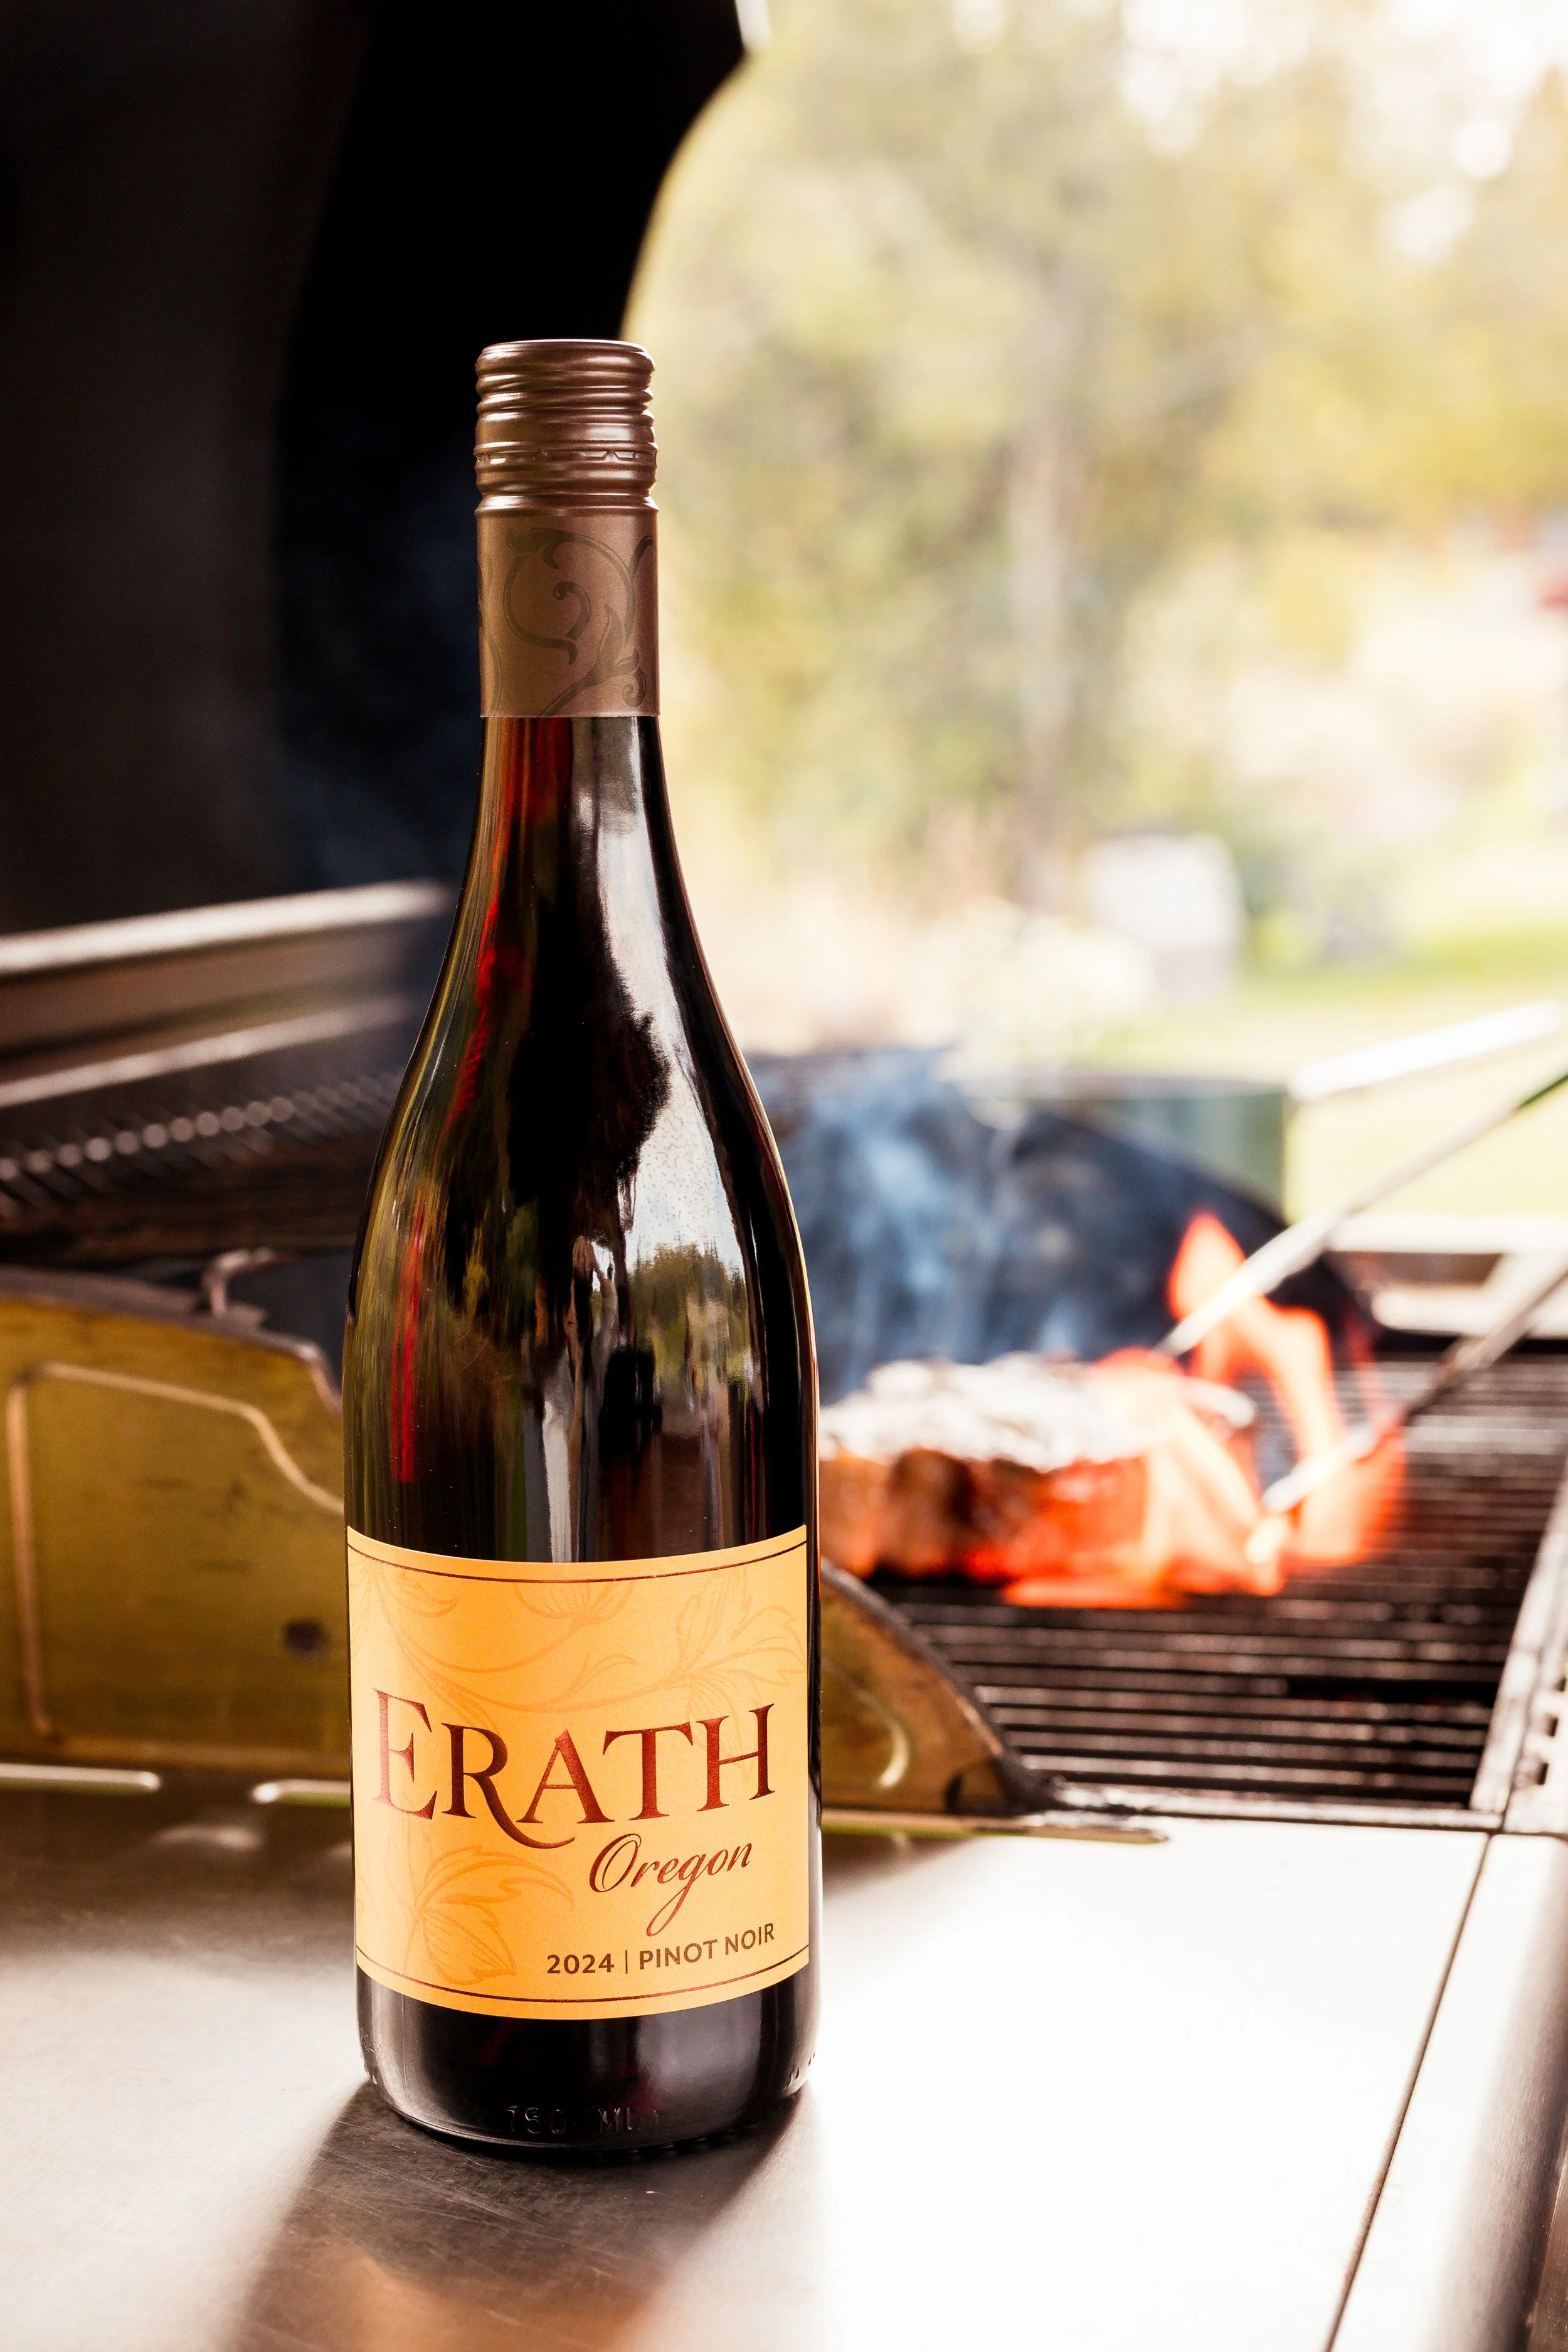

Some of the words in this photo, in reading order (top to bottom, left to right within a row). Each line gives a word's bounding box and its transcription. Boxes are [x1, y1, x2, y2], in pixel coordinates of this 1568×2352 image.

[373, 1688, 776, 1850] ERATH
[588, 1833, 753, 1937] Oregon
[546, 1953, 615, 1975] 2024
[638, 1939, 718, 1970] PINOT
[724, 1922, 775, 1956] NOIR
